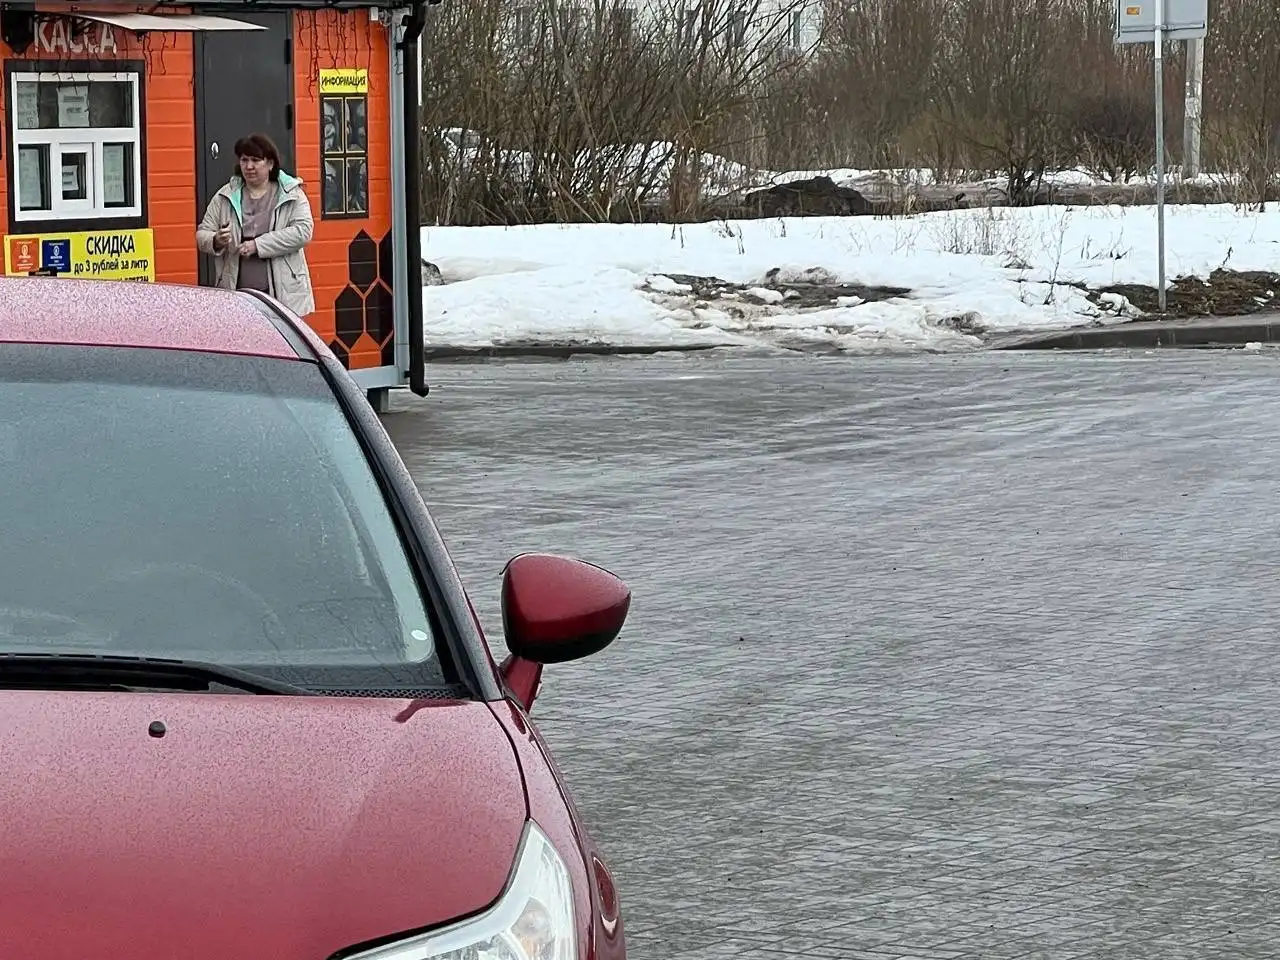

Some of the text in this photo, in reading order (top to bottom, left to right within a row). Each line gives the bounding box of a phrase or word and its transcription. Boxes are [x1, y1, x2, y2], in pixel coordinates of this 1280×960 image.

[321, 76, 366, 86] ИНФОРМАЦИЯ
[86, 234, 135, 257] СКИДКА
[74, 259, 149, 275] до 3 рублей за литр
